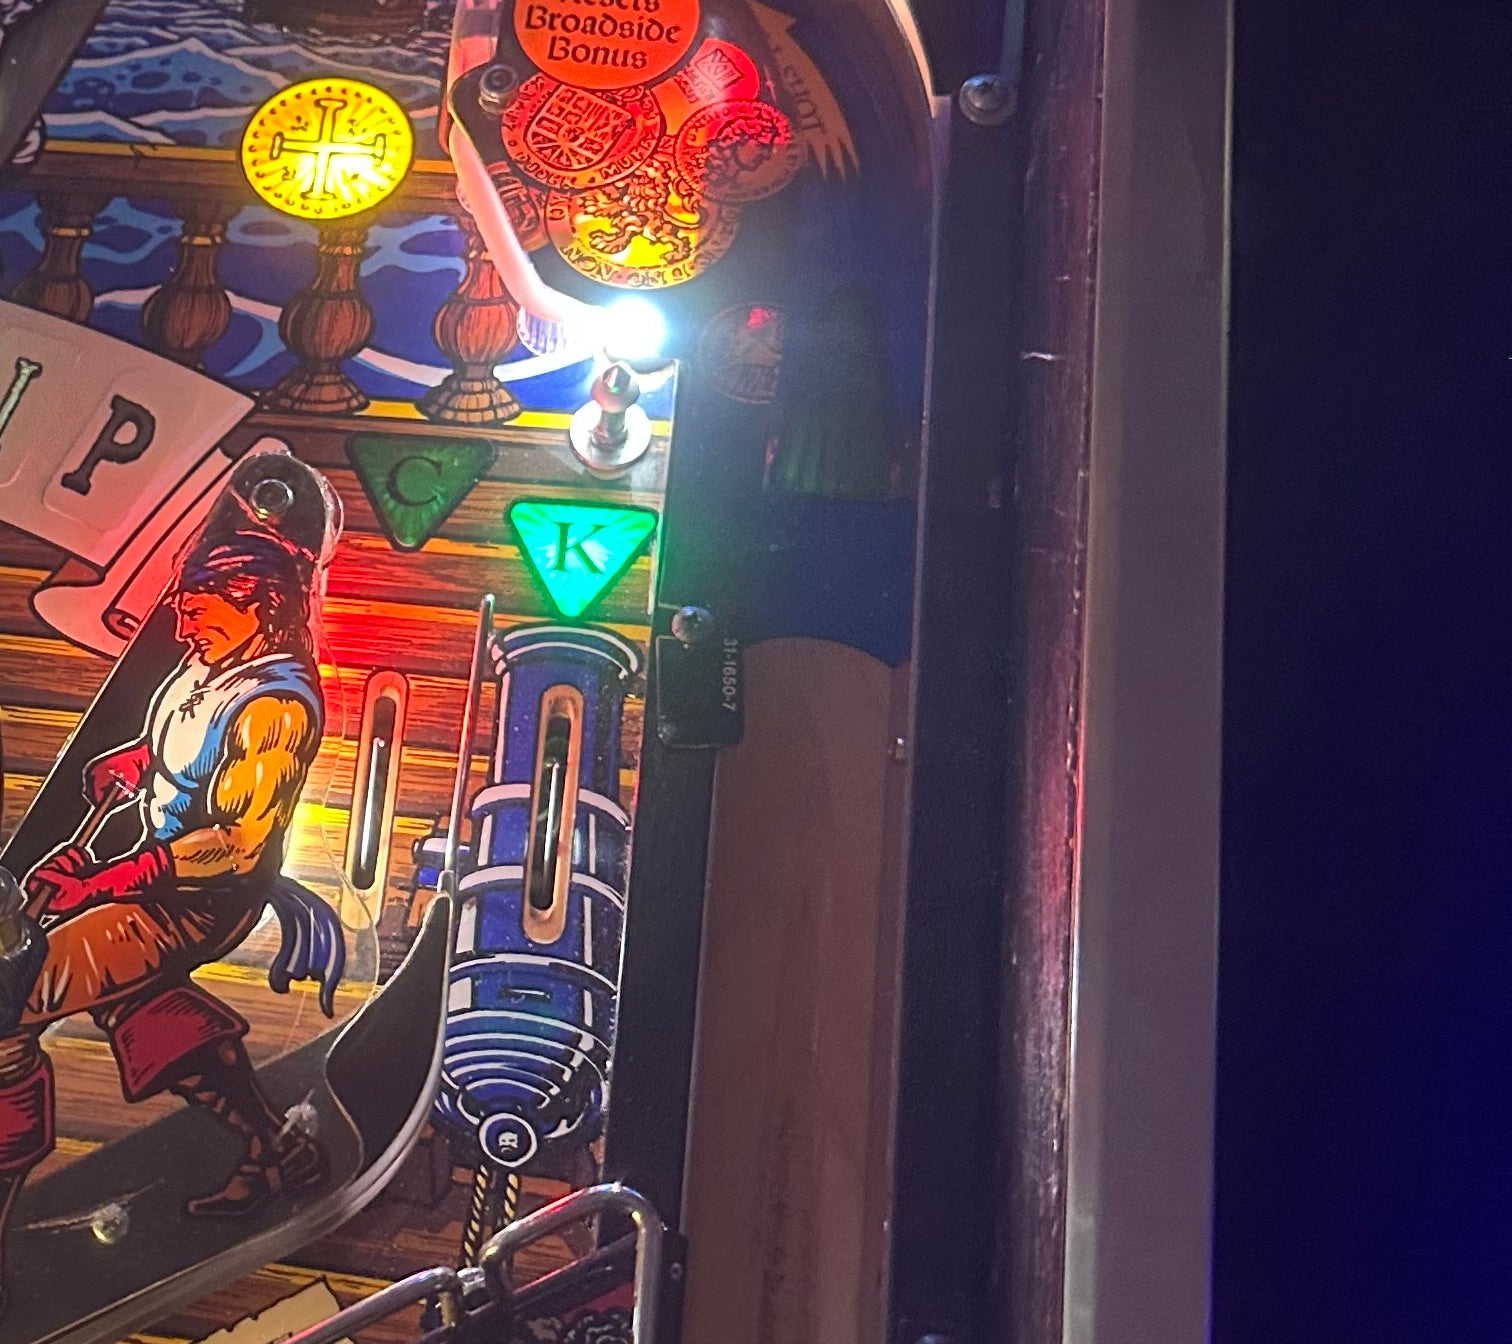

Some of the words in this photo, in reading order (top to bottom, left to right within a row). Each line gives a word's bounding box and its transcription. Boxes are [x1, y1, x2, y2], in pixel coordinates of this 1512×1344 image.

[525, 4, 682, 44] Broadside
[547, 36, 649, 70] Bonus
[388, 456, 442, 508] C
[551, 520, 605, 575] K
[722, 637, 740, 713] 31-1650-7
